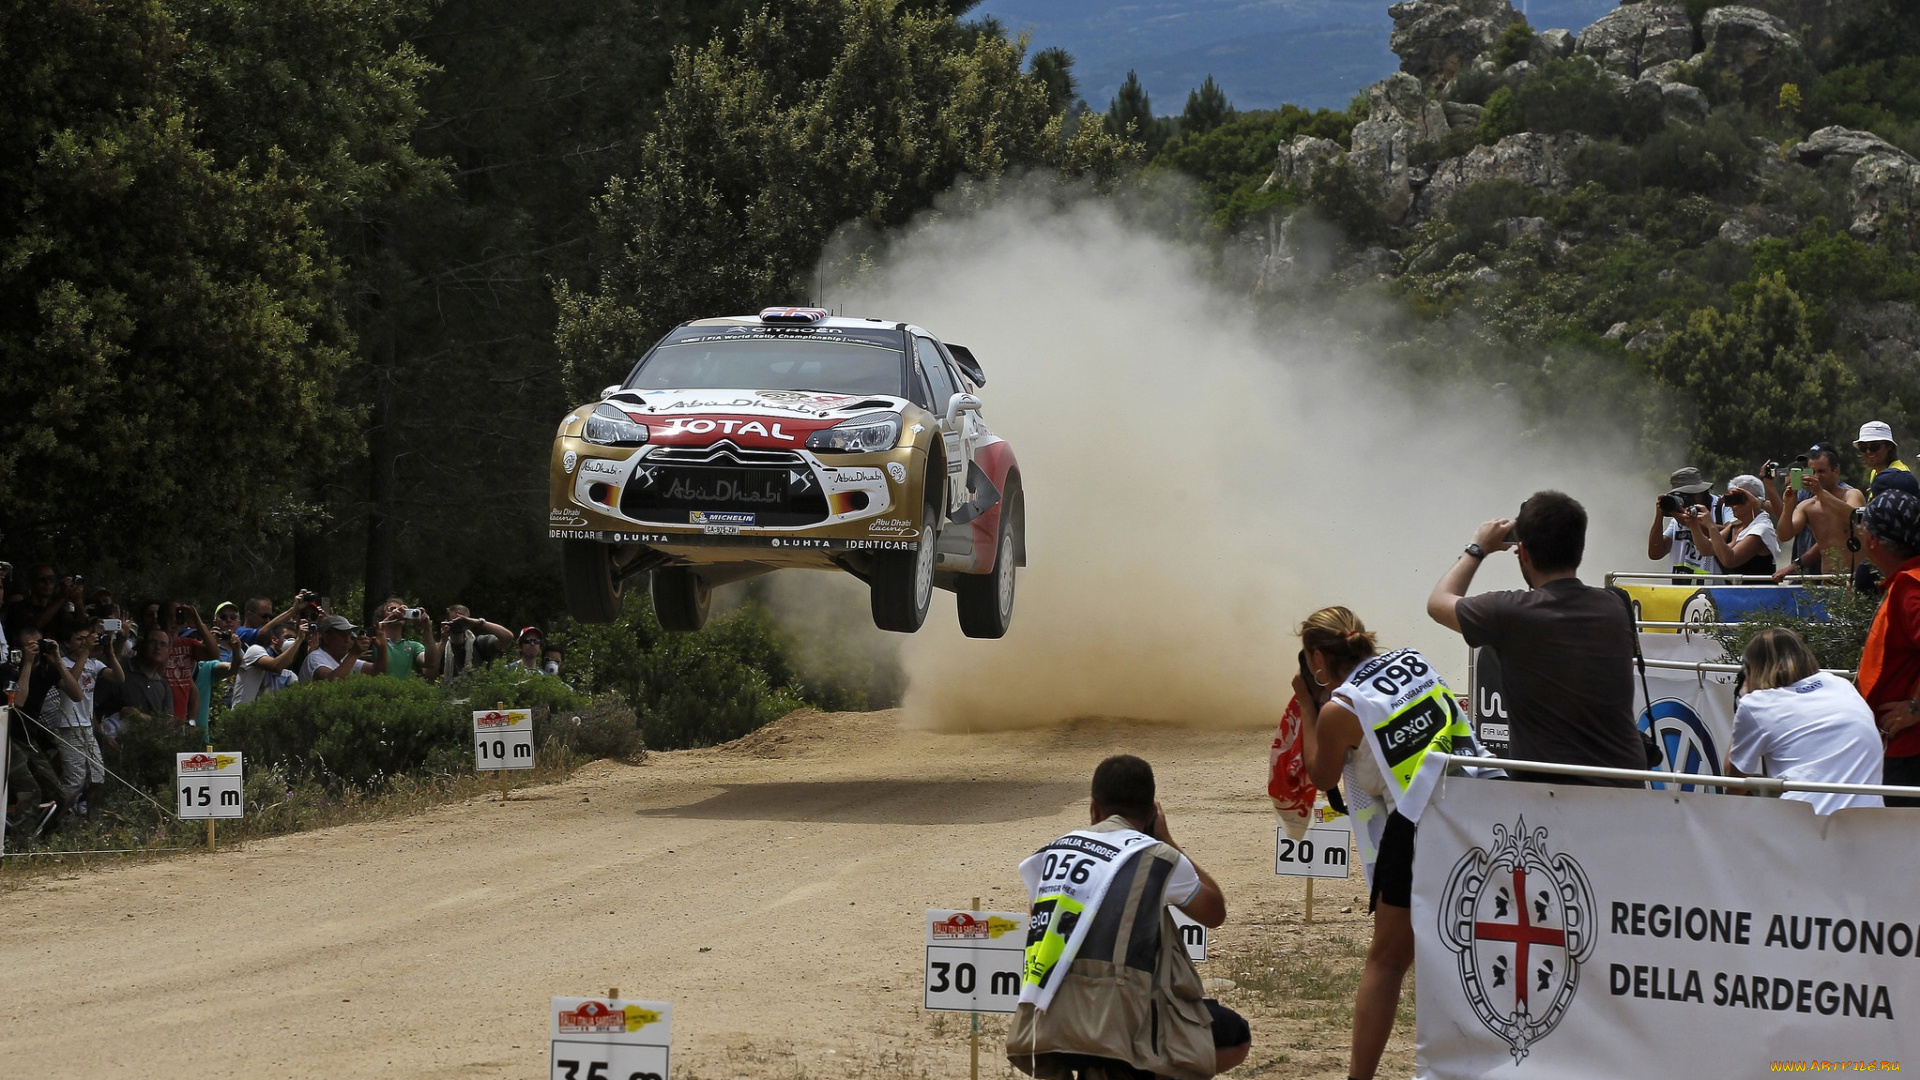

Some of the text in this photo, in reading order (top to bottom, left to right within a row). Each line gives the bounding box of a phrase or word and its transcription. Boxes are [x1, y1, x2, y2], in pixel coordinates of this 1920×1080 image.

[665, 417, 795, 441] TOTAL
[709, 514, 754, 522] MICHELIN
[549, 529, 595, 540] IDENTICAR
[623, 534, 668, 542] LUHTA
[783, 539, 830, 547] LUHTA
[846, 540, 909, 550] IDENTICAR
[1372, 655, 1429, 696] 098
[1390, 678, 1435, 710] PHOTOGRAPHER
[1385, 710, 1434, 750] Lexar
[478, 740, 531, 759] 10 m
[181, 786, 240, 807] 15 m
[1279, 838, 1347, 866] 20 m
[1041, 853, 1097, 885] 056
[1611, 901, 1920, 958] REGIONE AUTONO
[929, 961, 1021, 996] 30 m
[1609, 963, 1894, 1020] DELLA SARDEGNA
